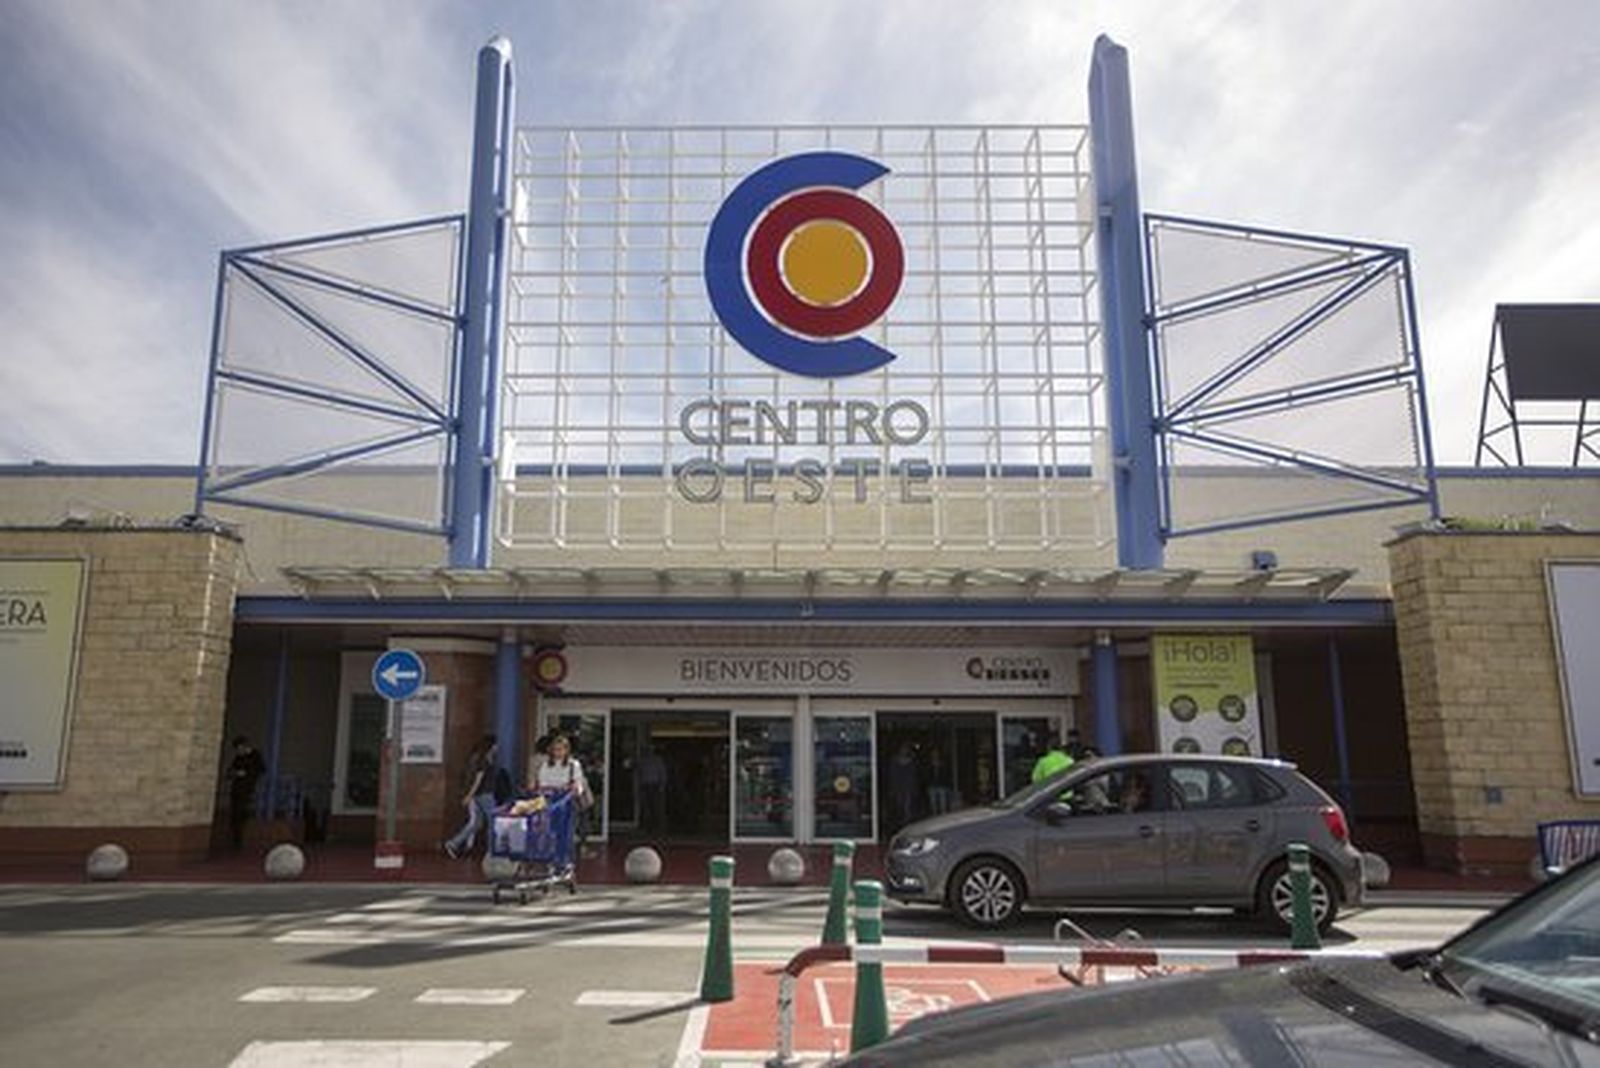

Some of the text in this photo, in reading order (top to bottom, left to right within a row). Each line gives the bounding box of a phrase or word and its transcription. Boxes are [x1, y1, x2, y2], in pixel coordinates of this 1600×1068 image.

[680, 399, 930, 446] CENTRO
[676, 457, 933, 504] OESTE
[1163, 640, 1238, 663] ¡Hola!
[680, 659, 852, 682] BIENVENIDOS
